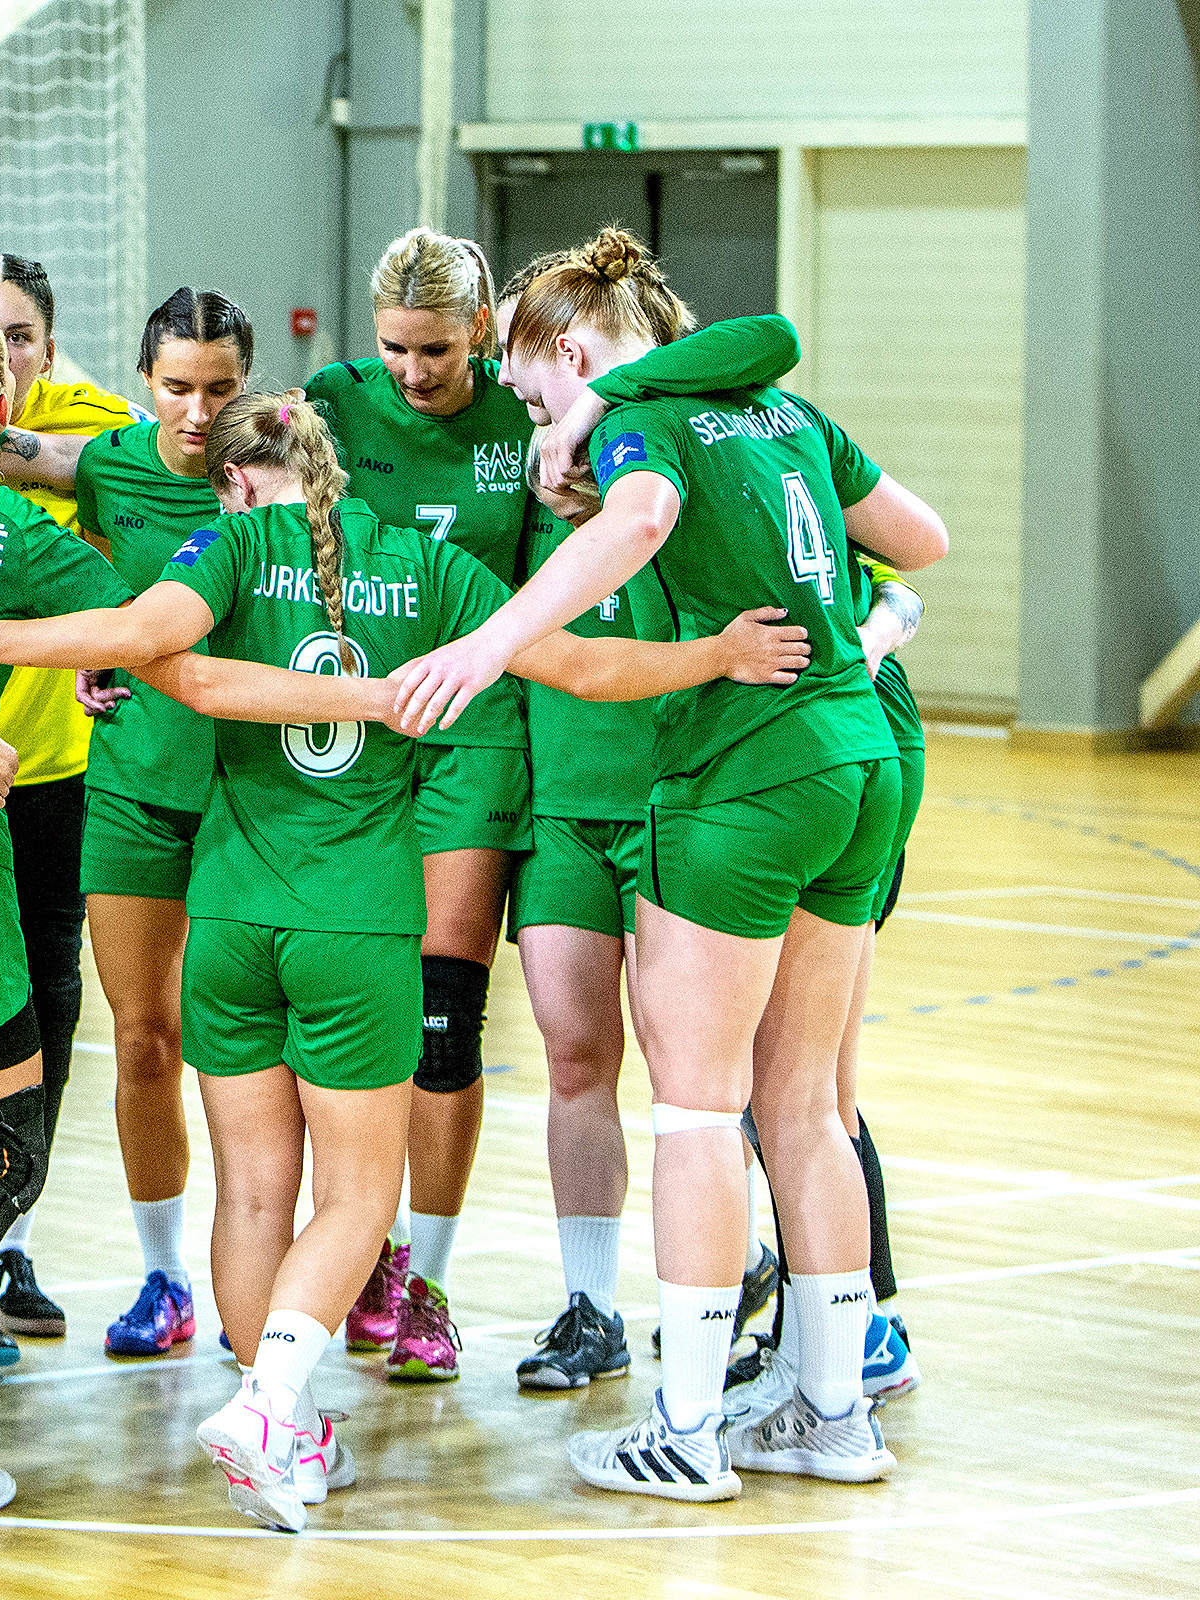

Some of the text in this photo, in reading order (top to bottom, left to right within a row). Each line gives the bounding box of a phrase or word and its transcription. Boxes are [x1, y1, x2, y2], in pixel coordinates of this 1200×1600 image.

[355, 457, 395, 475] JAKO
[487, 482, 521, 494] auga
[113, 514, 145, 530] JAKO
[781, 471, 837, 605] 4
[253, 561, 419, 619] JURKEIČIŪTĖ
[280, 630, 370, 779] 3
[485, 810, 518, 823] JAKO
[422, 1015, 449, 1029] LECT
[700, 1309, 737, 1321] JAK
